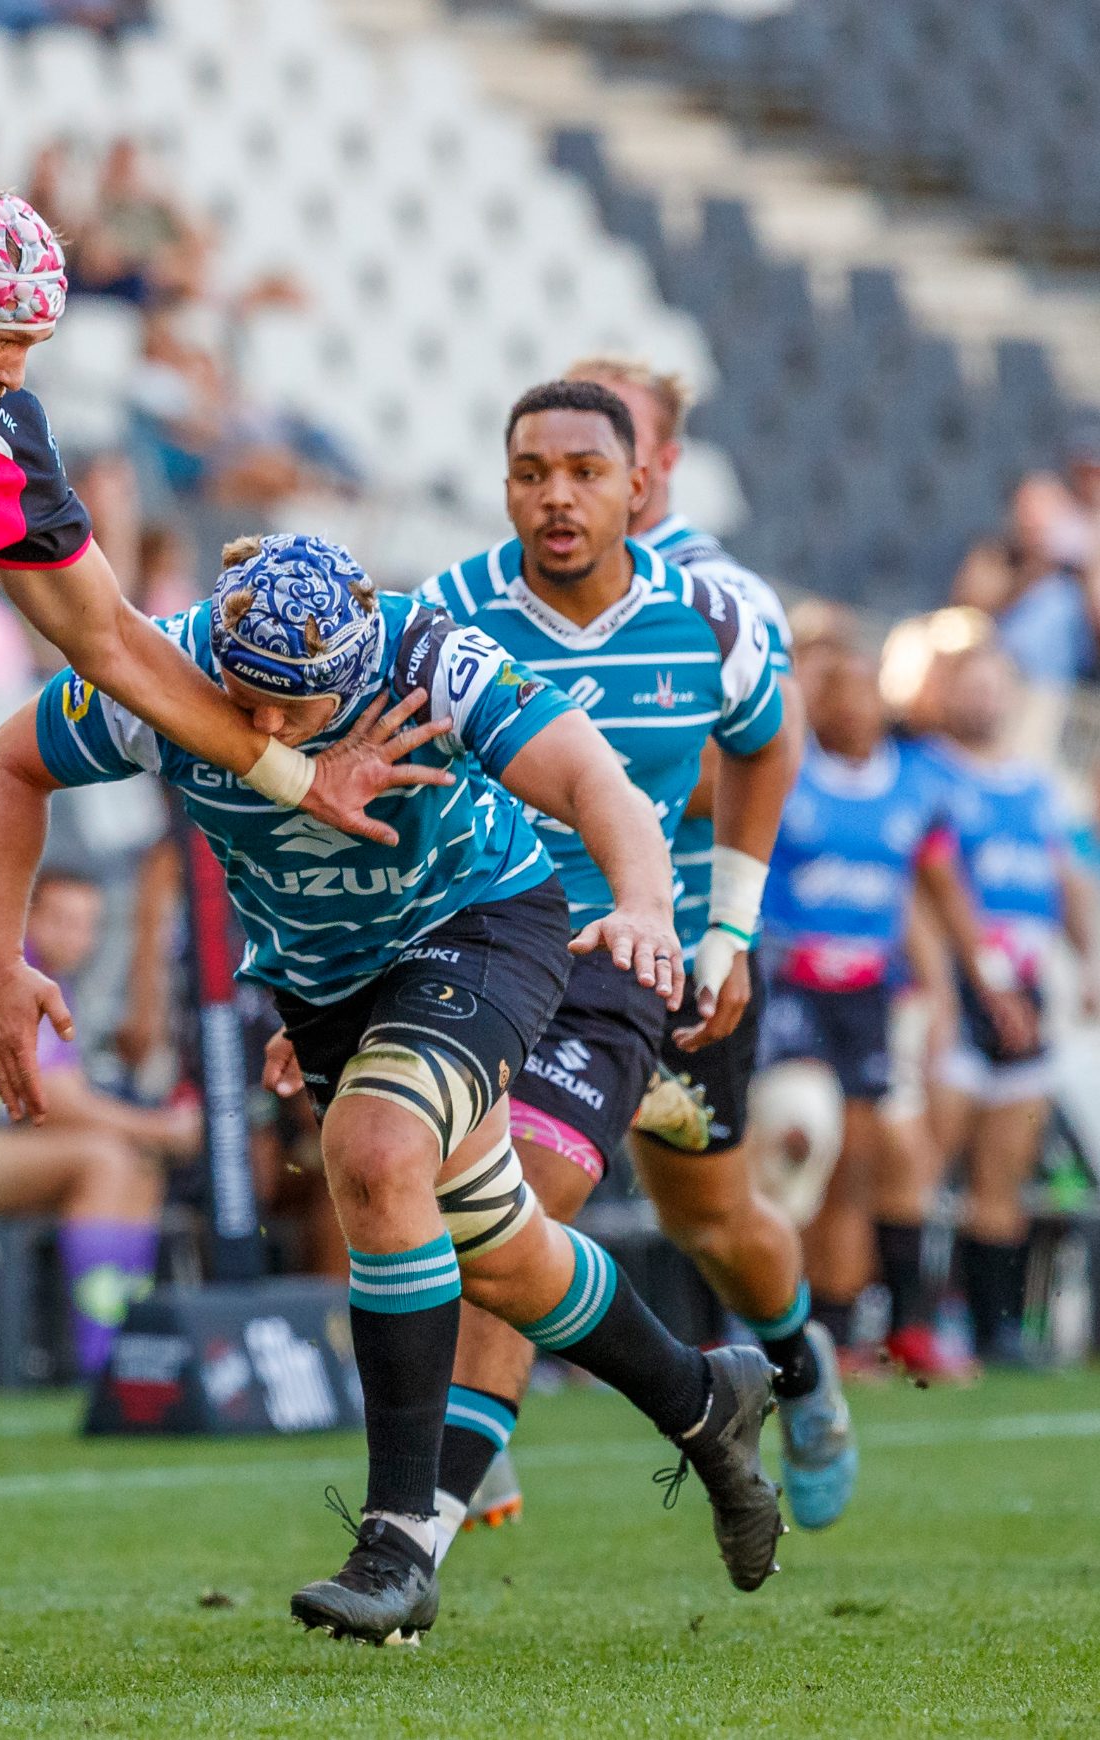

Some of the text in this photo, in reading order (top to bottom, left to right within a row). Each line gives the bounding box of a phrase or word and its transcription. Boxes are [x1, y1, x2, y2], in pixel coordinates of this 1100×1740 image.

[233, 662, 291, 687] IMPACT
[256, 847, 438, 896] UZUKI
[399, 947, 460, 963] ZUKI
[524, 1054, 605, 1110] SUZUKI
